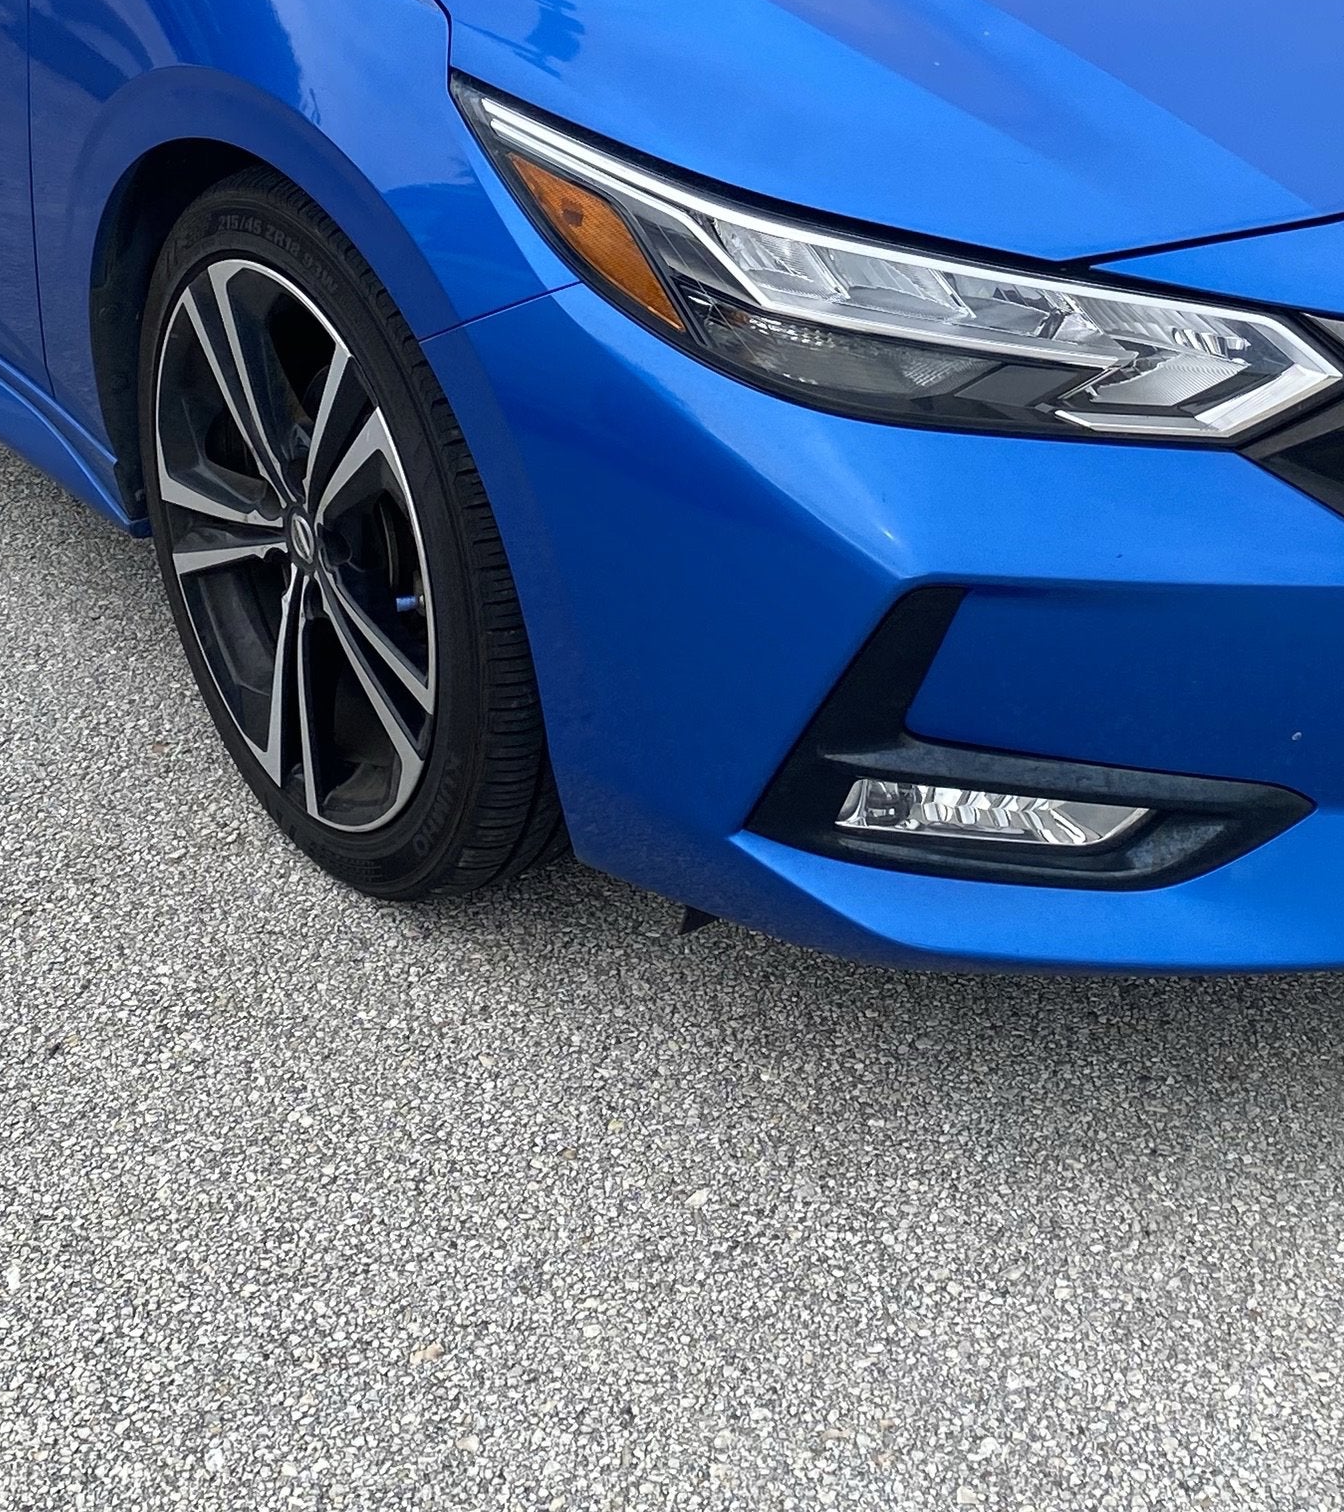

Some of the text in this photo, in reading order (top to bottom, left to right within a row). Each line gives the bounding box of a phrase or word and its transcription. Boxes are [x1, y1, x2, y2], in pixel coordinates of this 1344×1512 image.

[218, 214, 340, 294] 215/45 ZR18 93W
